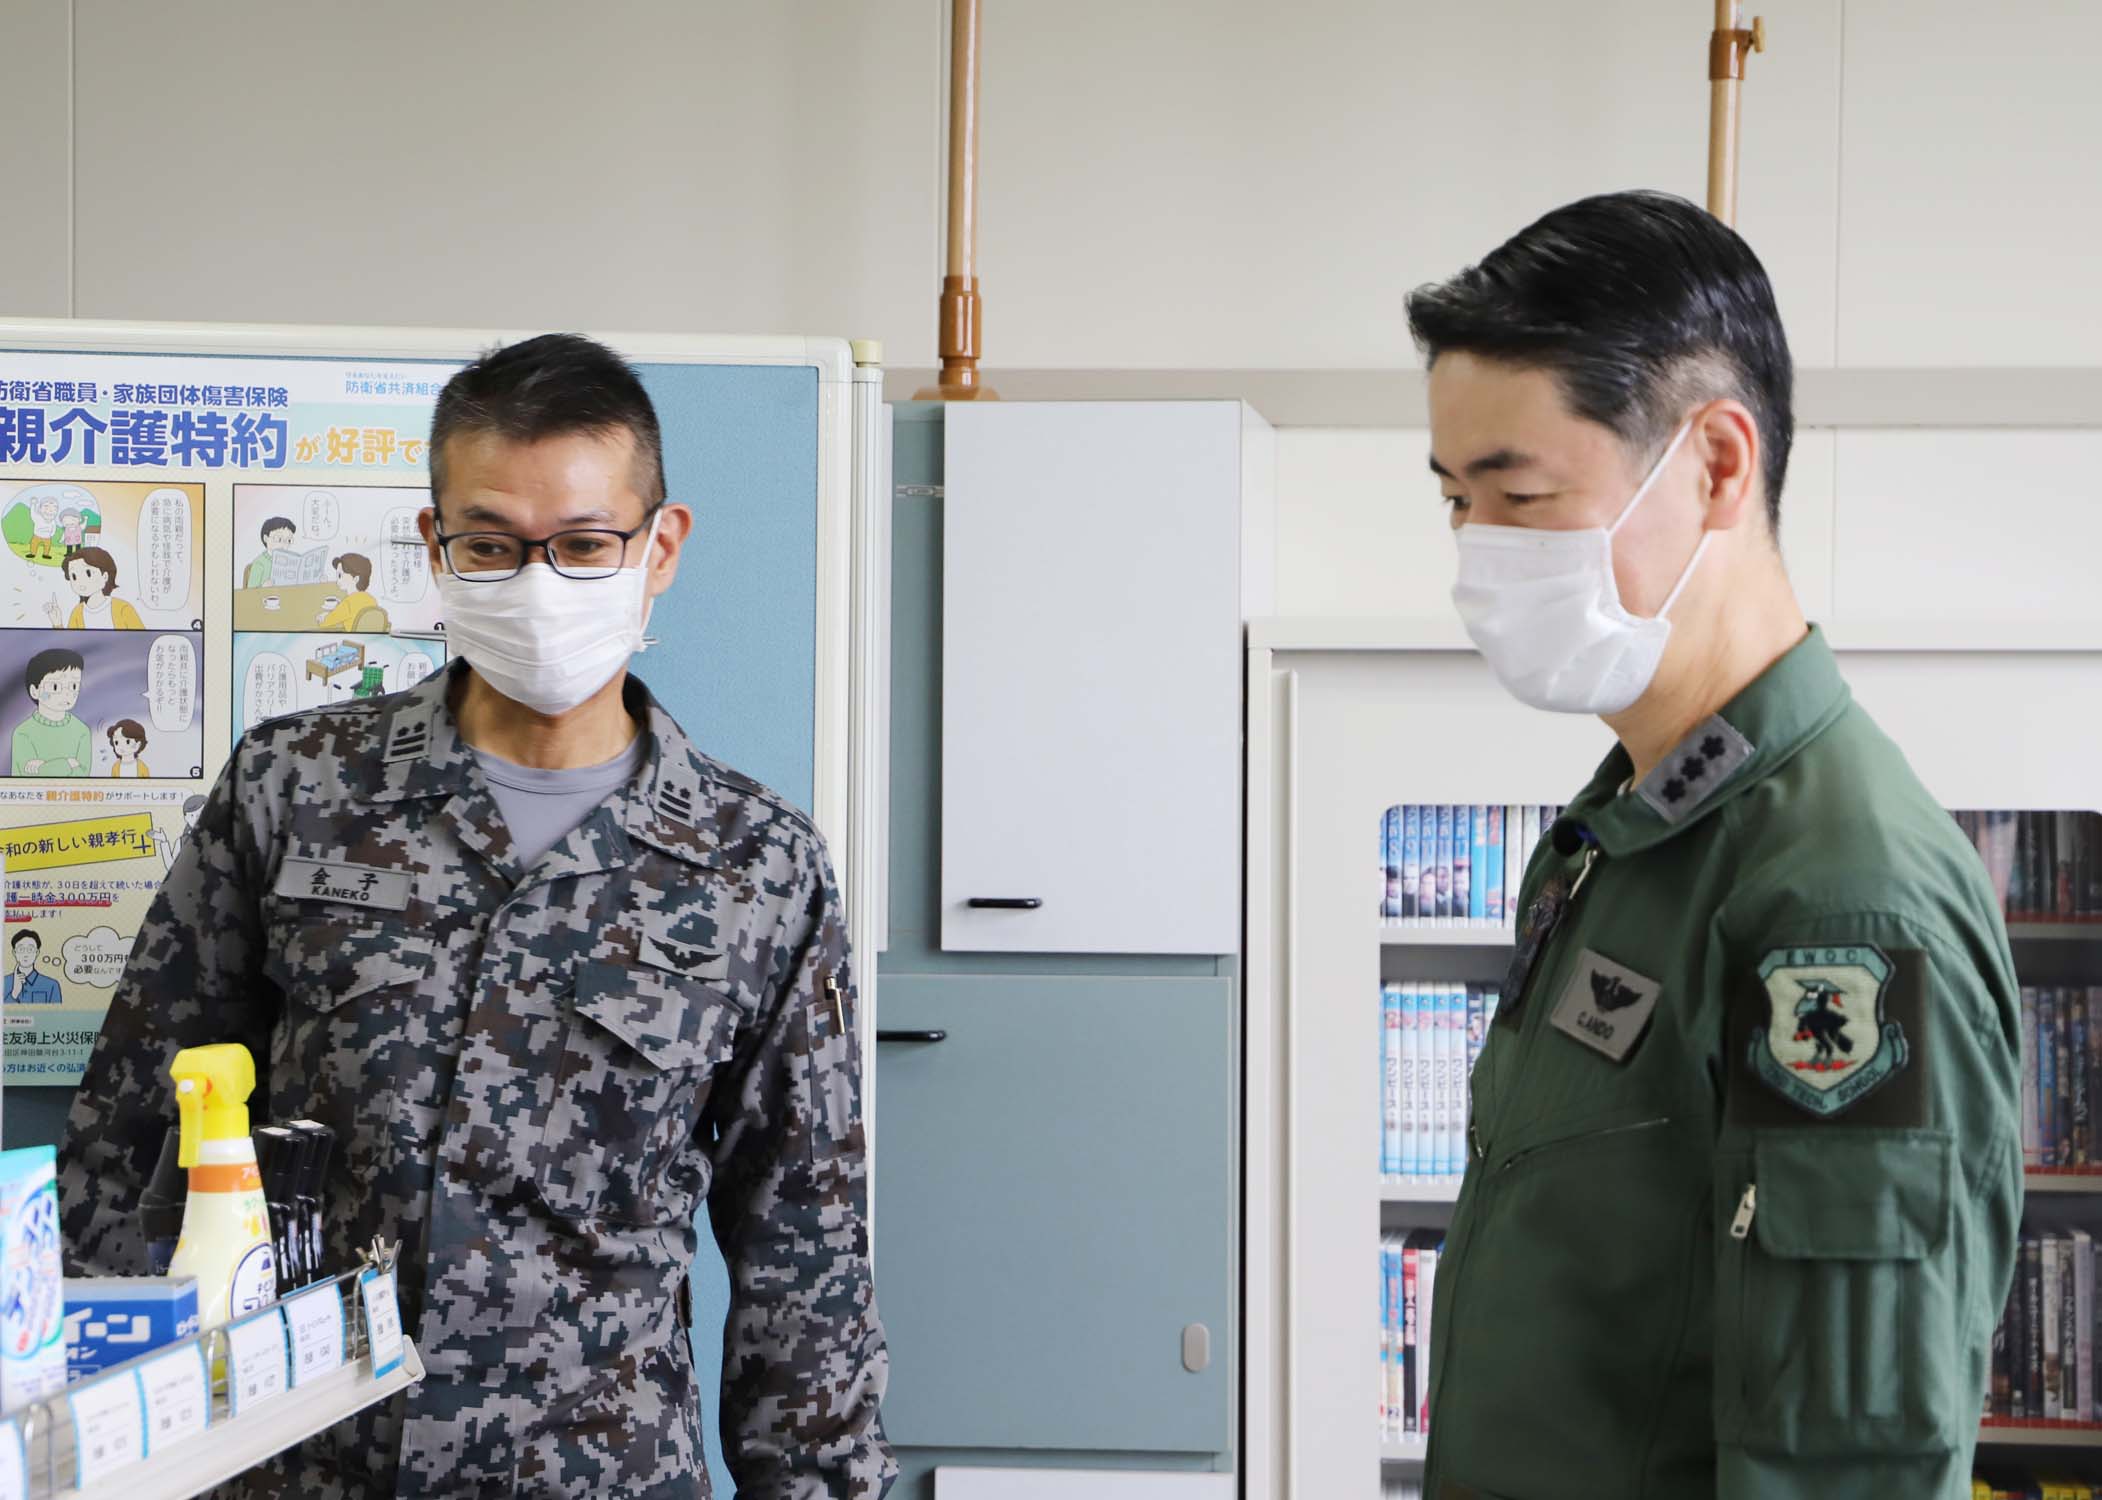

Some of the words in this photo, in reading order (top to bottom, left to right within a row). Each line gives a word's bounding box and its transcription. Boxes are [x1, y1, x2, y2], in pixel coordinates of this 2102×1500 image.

[0, 405, 288, 469] 親介護特約
[296, 426, 431, 464] が好評で
[0, 829, 136, 858] 和の新しい親孝行
[312, 886, 370, 902] KANEKO
[3, 1031, 98, 1045] 友海上火災保
